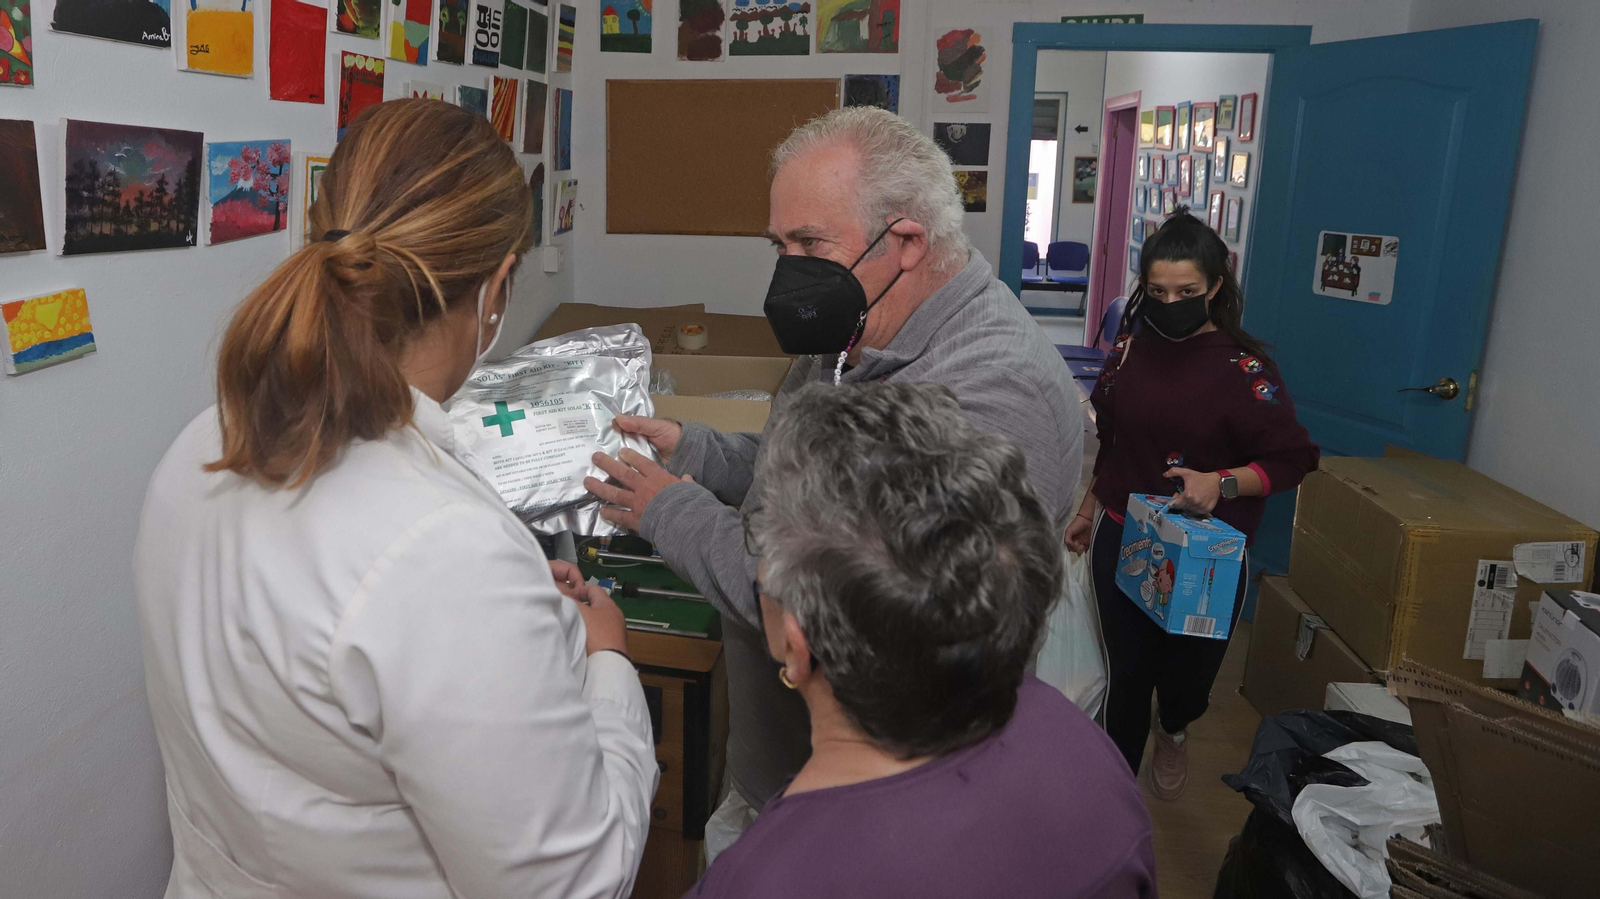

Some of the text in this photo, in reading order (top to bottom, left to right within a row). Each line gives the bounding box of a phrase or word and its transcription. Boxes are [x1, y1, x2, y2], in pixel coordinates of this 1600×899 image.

[472, 374, 506, 384] "SOLAS"
[508, 370, 528, 380] FIRST
[529, 366, 542, 374] AID
[530, 398, 564, 408] 1056105
[1208, 538, 1238, 552] Crecimiento
